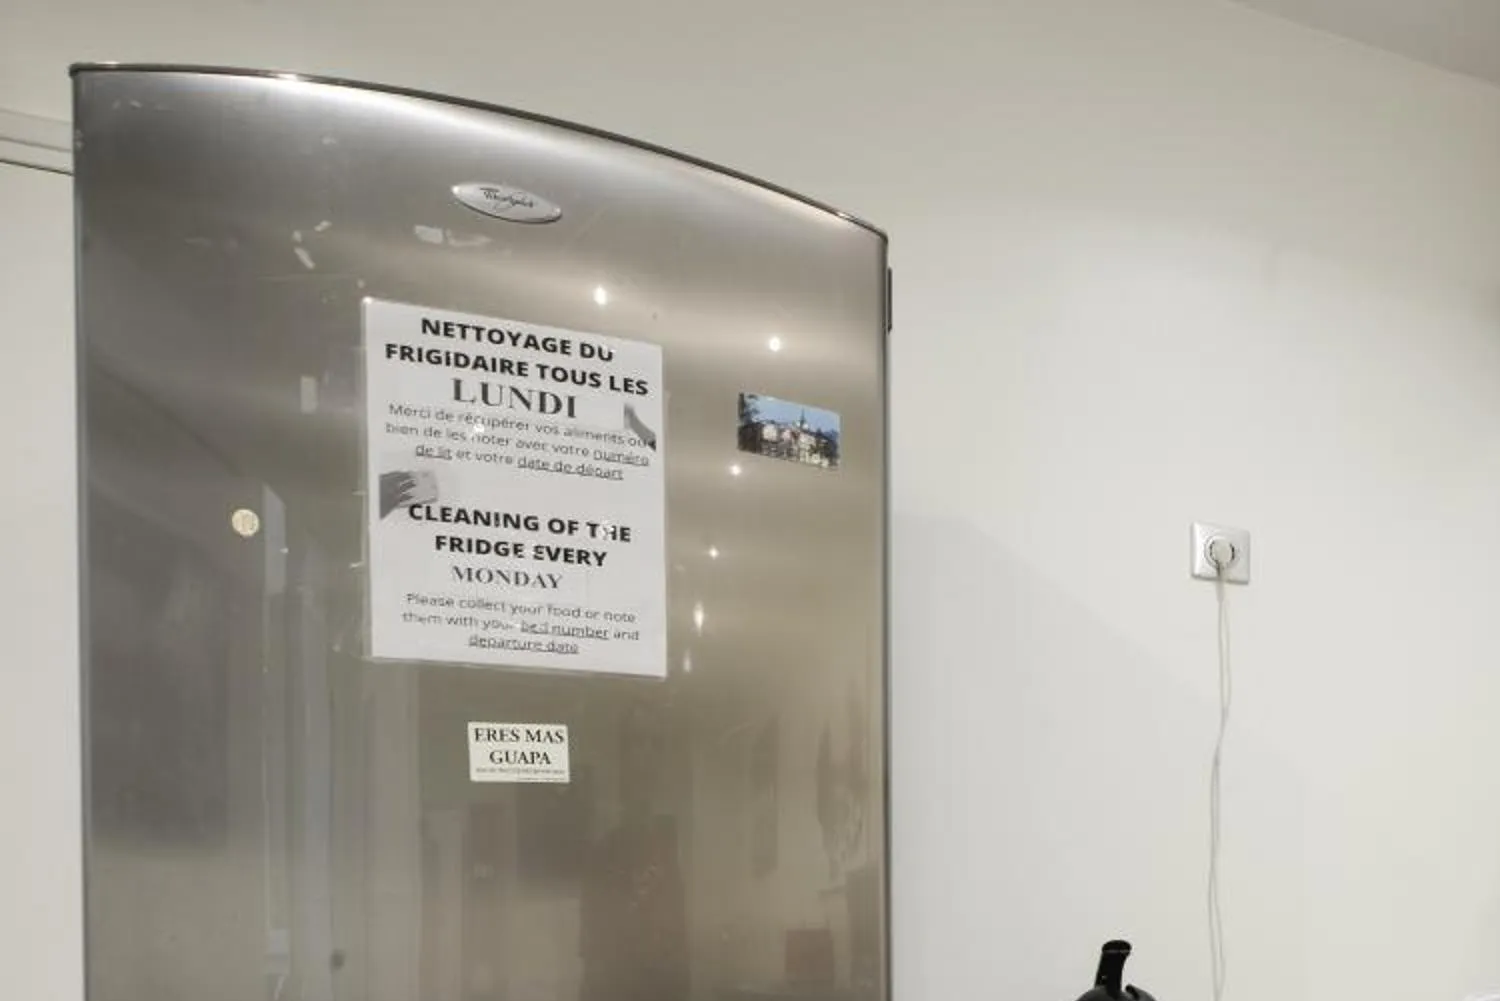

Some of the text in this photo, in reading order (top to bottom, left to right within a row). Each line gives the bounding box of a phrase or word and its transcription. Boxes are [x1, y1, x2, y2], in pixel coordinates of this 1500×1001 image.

[421, 318, 614, 362] NETTOYAGE DU
[385, 343, 649, 396] FRIGIDAIRE TOUS LES
[451, 378, 578, 419] LUNDI
[389, 403, 431, 419] Merci
[435, 410, 454, 421] de
[535, 424, 560, 435] vos
[385, 422, 419, 436] bien
[424, 426, 442, 438] de
[446, 428, 467, 441] les
[516, 439, 547, 452] avec
[552, 443, 590, 457] votre
[415, 444, 434, 457] de
[456, 449, 471, 461] et
[476, 452, 513, 465] votre
[517, 455, 550, 471] date
[553, 460, 572, 474] de
[408, 503, 632, 543] CLEANING OF THE
[435, 535, 608, 567] FRIDGE EVERY
[451, 565, 564, 590] MONDAY
[406, 592, 455, 608] Please
[509, 604, 544, 617] your
[546, 604, 581, 618] food
[585, 609, 600, 620] or
[603, 610, 637, 623] note
[401, 612, 442, 626] them
[446, 615, 479, 629] with
[551, 624, 610, 640] number
[613, 629, 640, 641] and
[474, 727, 565, 744] ERES MAS
[489, 750, 552, 765] GUAPA
